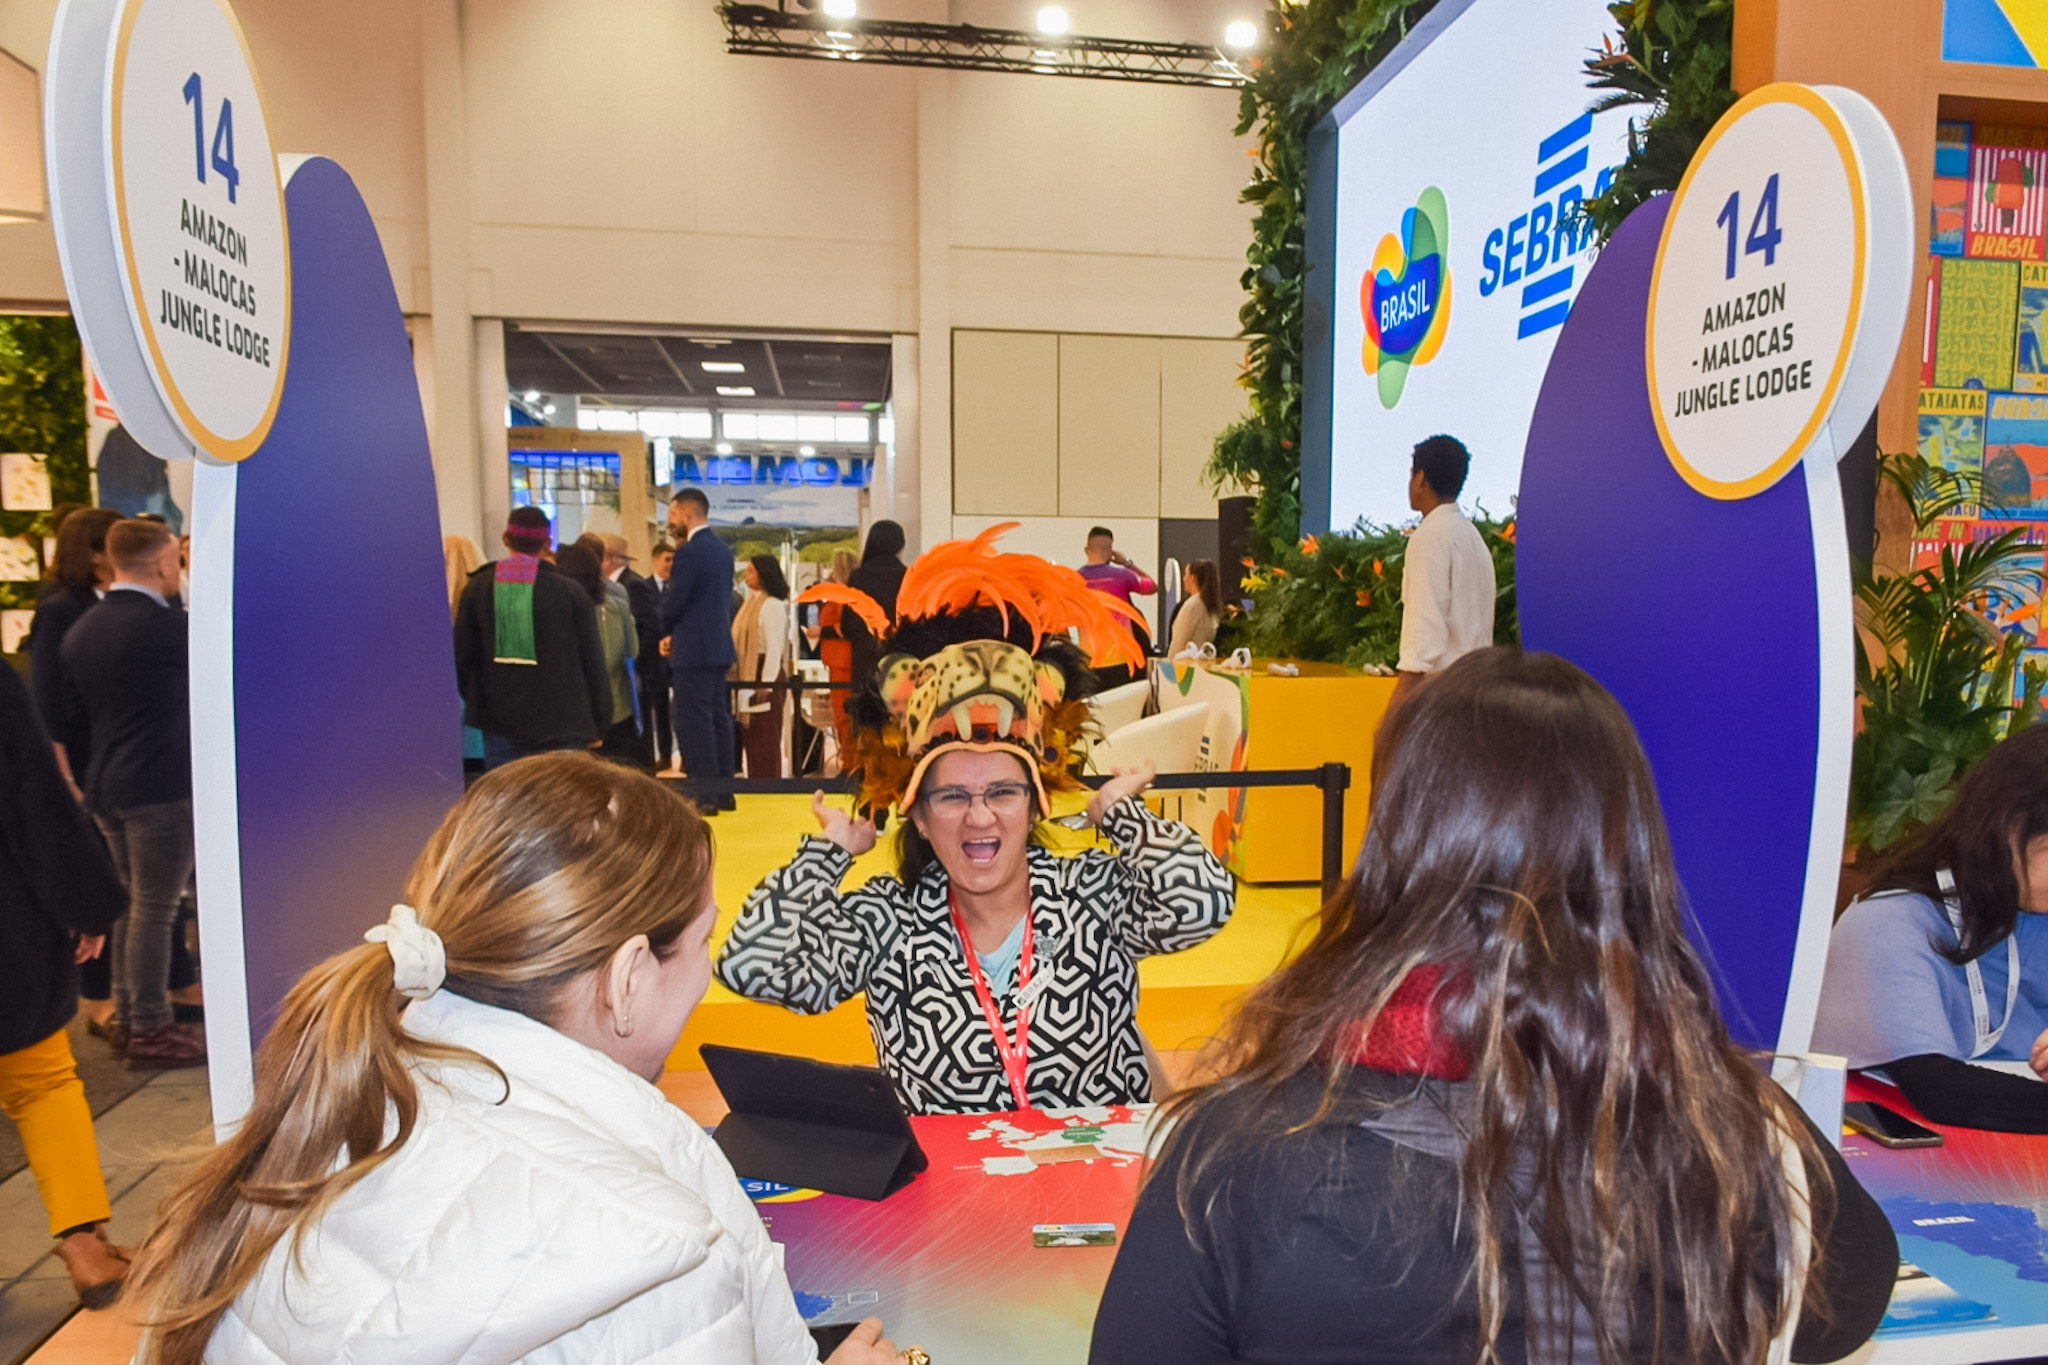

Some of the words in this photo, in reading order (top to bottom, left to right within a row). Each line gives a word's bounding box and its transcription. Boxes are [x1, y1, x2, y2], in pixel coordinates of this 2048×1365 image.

[182, 71, 240, 205] 14
[180, 198, 248, 268] AMAZON
[1716, 173, 1783, 281] 14
[1970, 234, 2039, 259] BRASIL
[183, 249, 257, 318] MALOCAS
[1379, 278, 1431, 333] BRASIL
[1702, 283, 1787, 336] AMAZON
[160, 288, 222, 349] JUNGLE
[225, 318, 271, 368] LODGE
[1702, 325, 1795, 375] MALOCAS
[1674, 382, 1740, 418] JUNGLE
[1745, 359, 1813, 401] LODGE
[1948, 521, 1965, 539] IN
